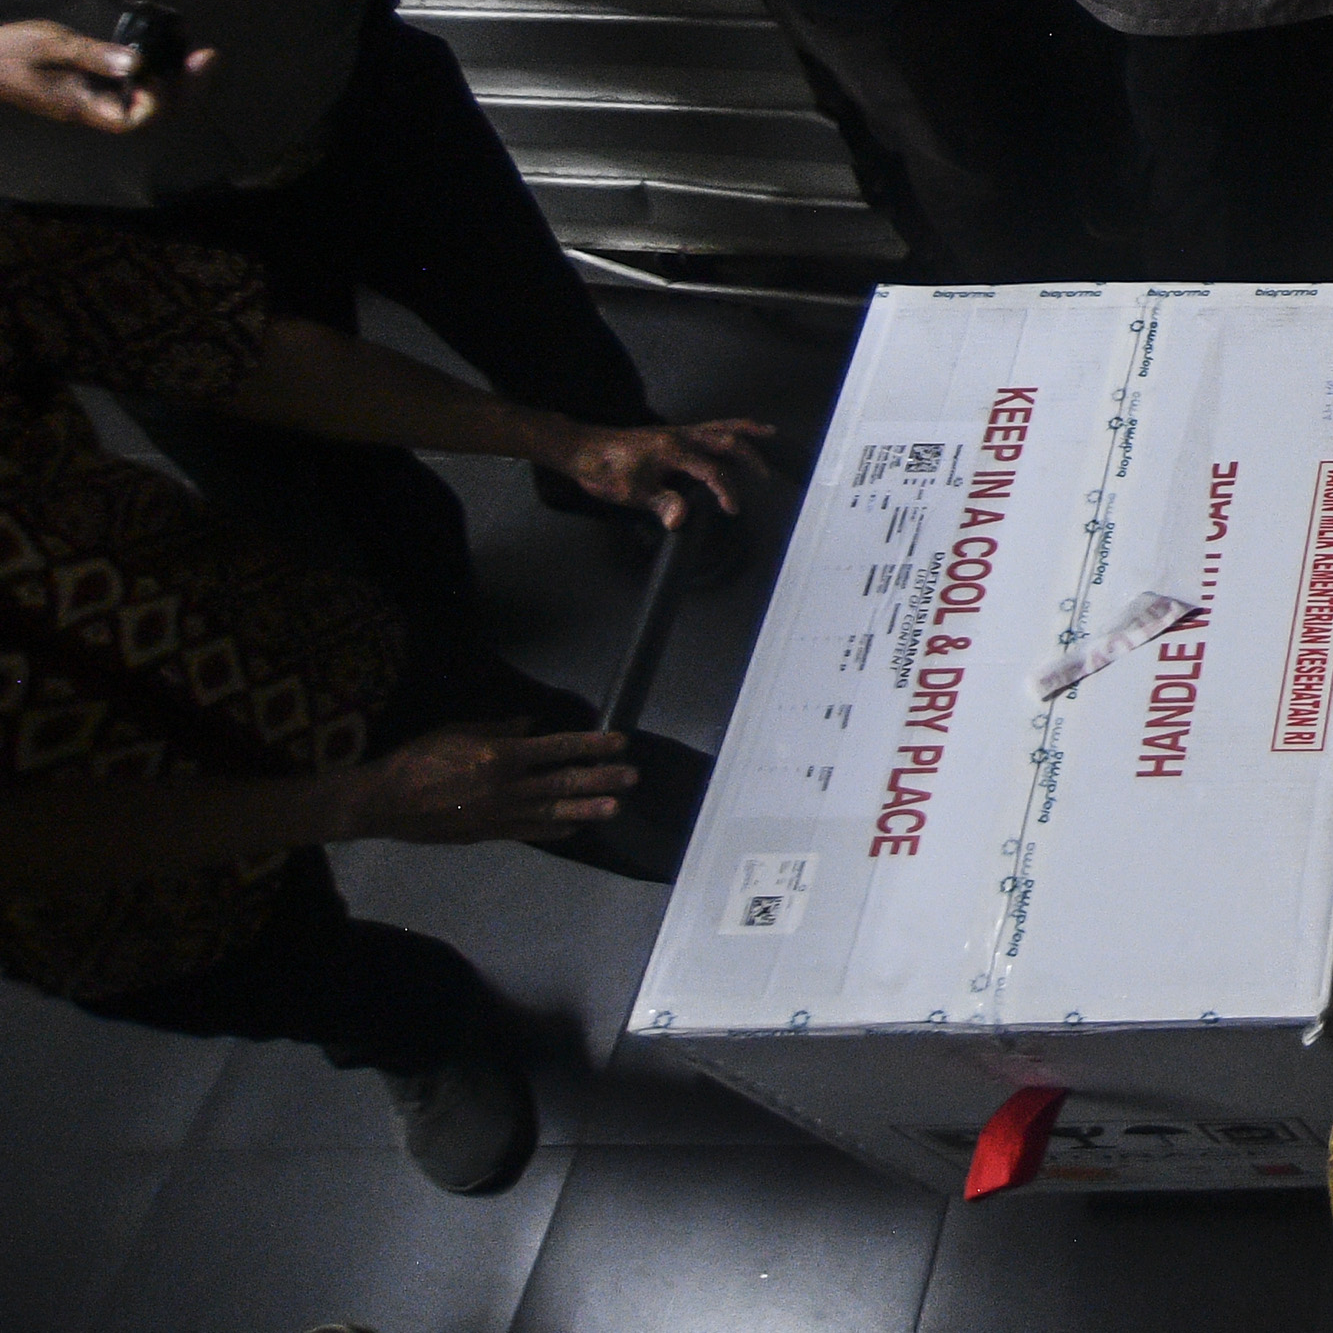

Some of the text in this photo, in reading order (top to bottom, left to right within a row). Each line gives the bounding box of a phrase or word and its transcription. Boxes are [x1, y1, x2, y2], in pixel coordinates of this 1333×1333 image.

[1092, 522, 1115, 585] biofarma
[1116, 419, 1138, 478] biofarma
[1138, 321, 1158, 377] biofarma
[869, 387, 1038, 857] KEEP IN A COOL & DRY PLACE
[1285, 648, 1329, 727] KESEHATAN
[1136, 642, 1206, 778] HANDLE
[1283, 732, 1316, 745] RI
